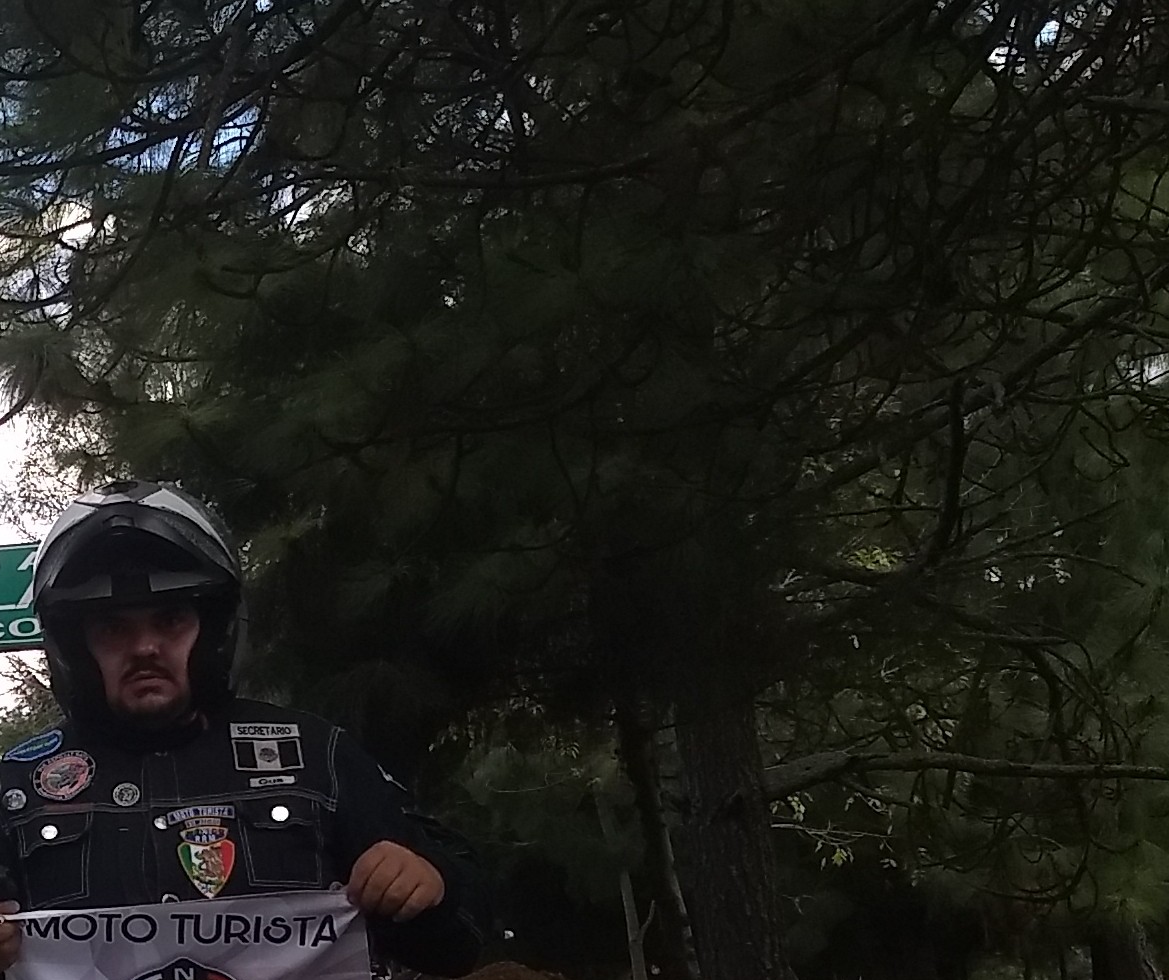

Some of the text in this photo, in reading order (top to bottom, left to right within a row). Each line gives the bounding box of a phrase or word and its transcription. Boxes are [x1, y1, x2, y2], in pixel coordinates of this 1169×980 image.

[237, 726, 292, 736] SECRETARIO
[25, 913, 338, 947] MOTO TURISTA
